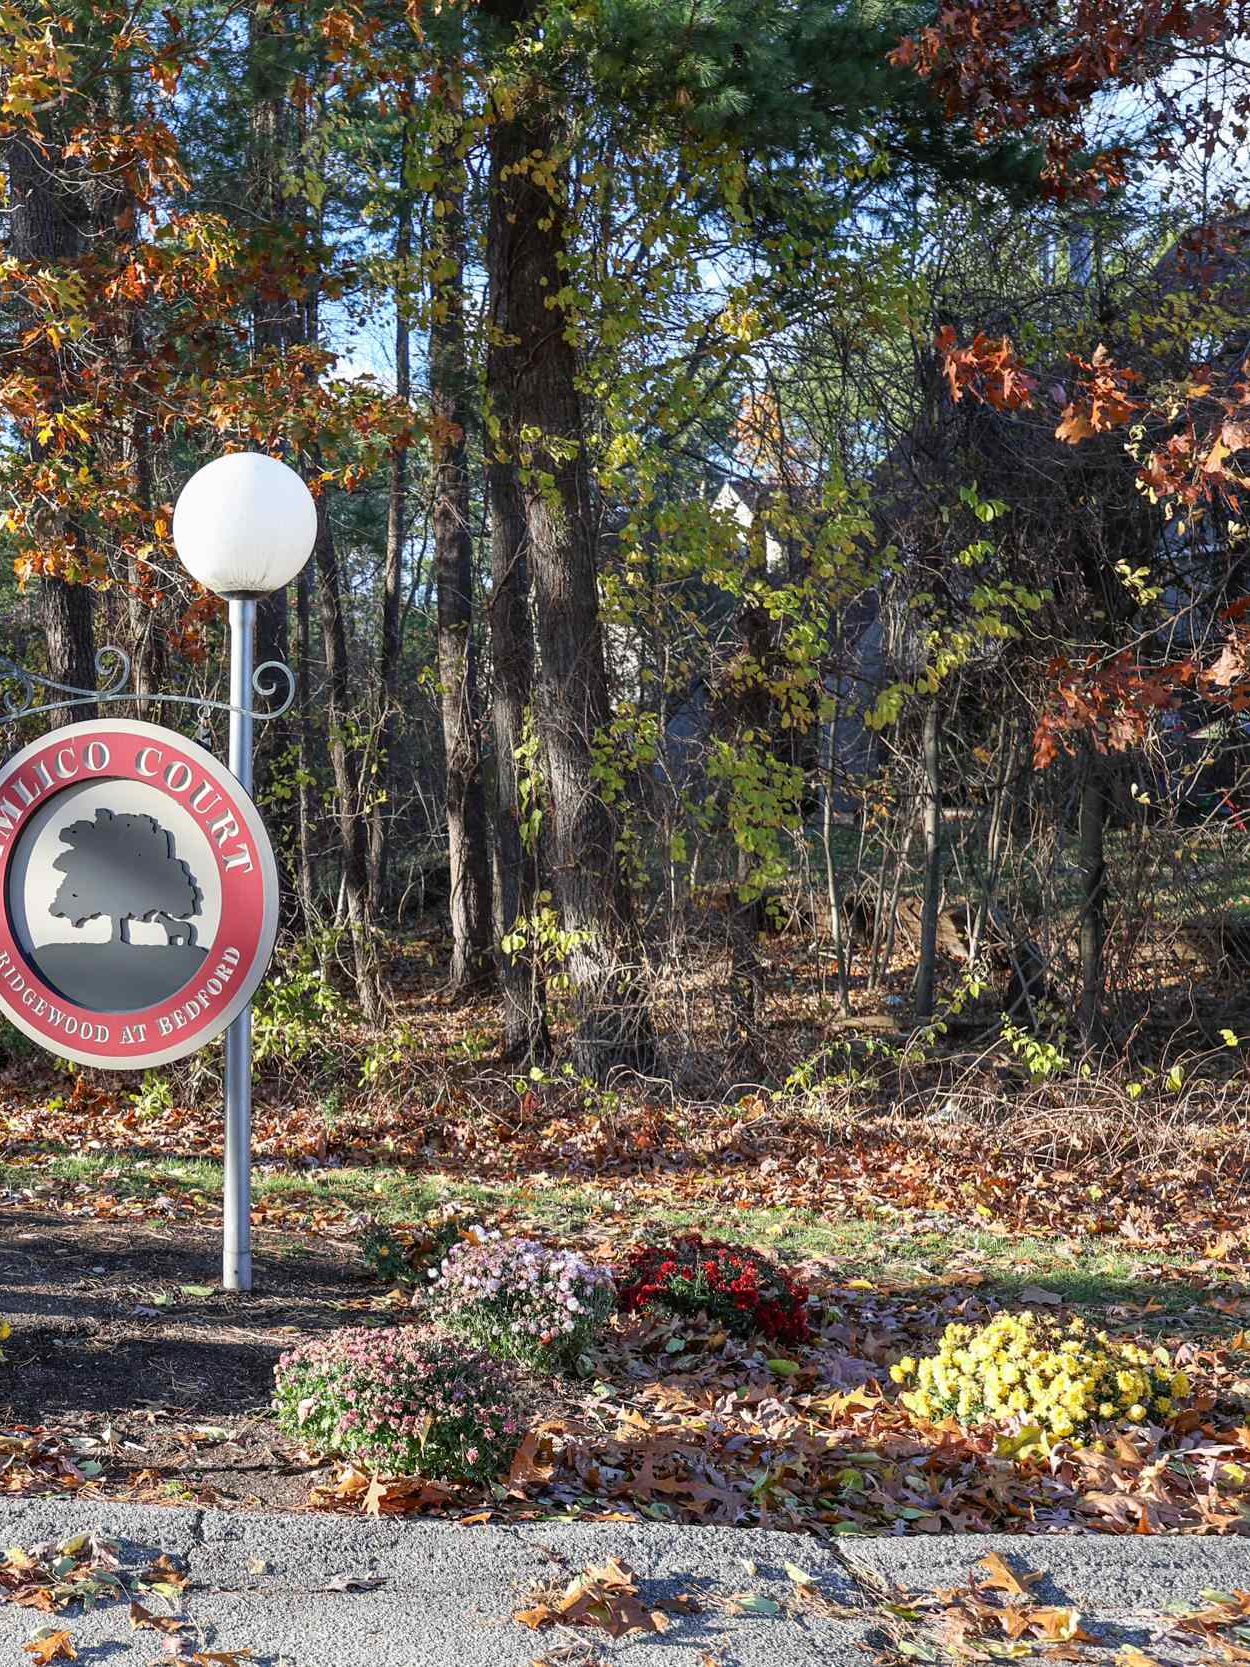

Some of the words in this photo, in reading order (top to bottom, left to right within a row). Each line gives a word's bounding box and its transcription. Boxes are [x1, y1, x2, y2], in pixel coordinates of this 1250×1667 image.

[135, 747, 254, 875] COURT
[120, 1023, 148, 1044] AT
[158, 946, 241, 1037] BEDFORD
